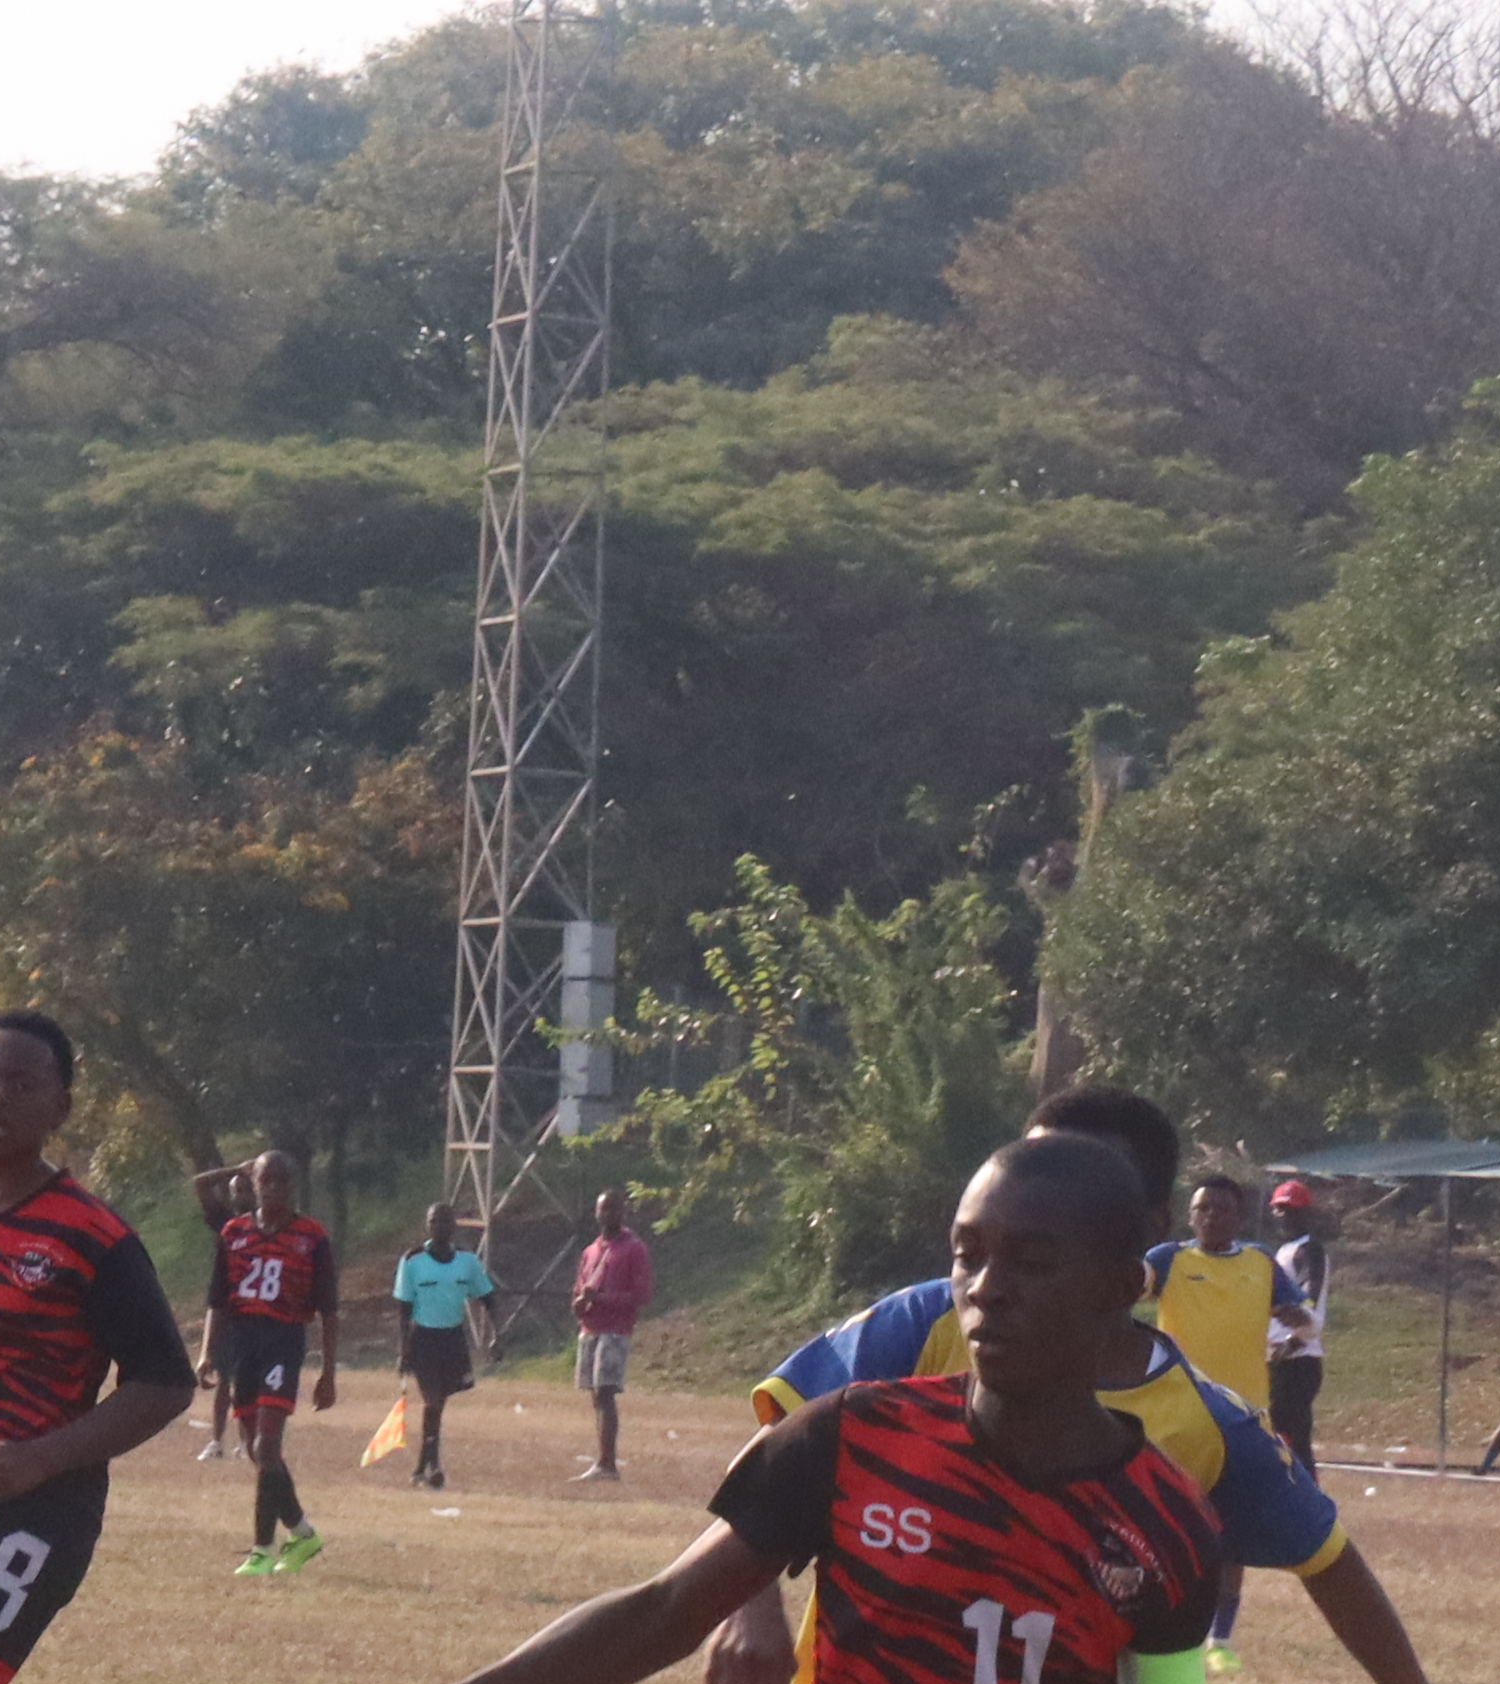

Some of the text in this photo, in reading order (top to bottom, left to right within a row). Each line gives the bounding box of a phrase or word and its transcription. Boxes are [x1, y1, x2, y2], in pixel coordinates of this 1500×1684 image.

[239, 1256, 283, 1302] 28
[264, 1364, 285, 1391] 4
[860, 1503, 932, 1554] SS
